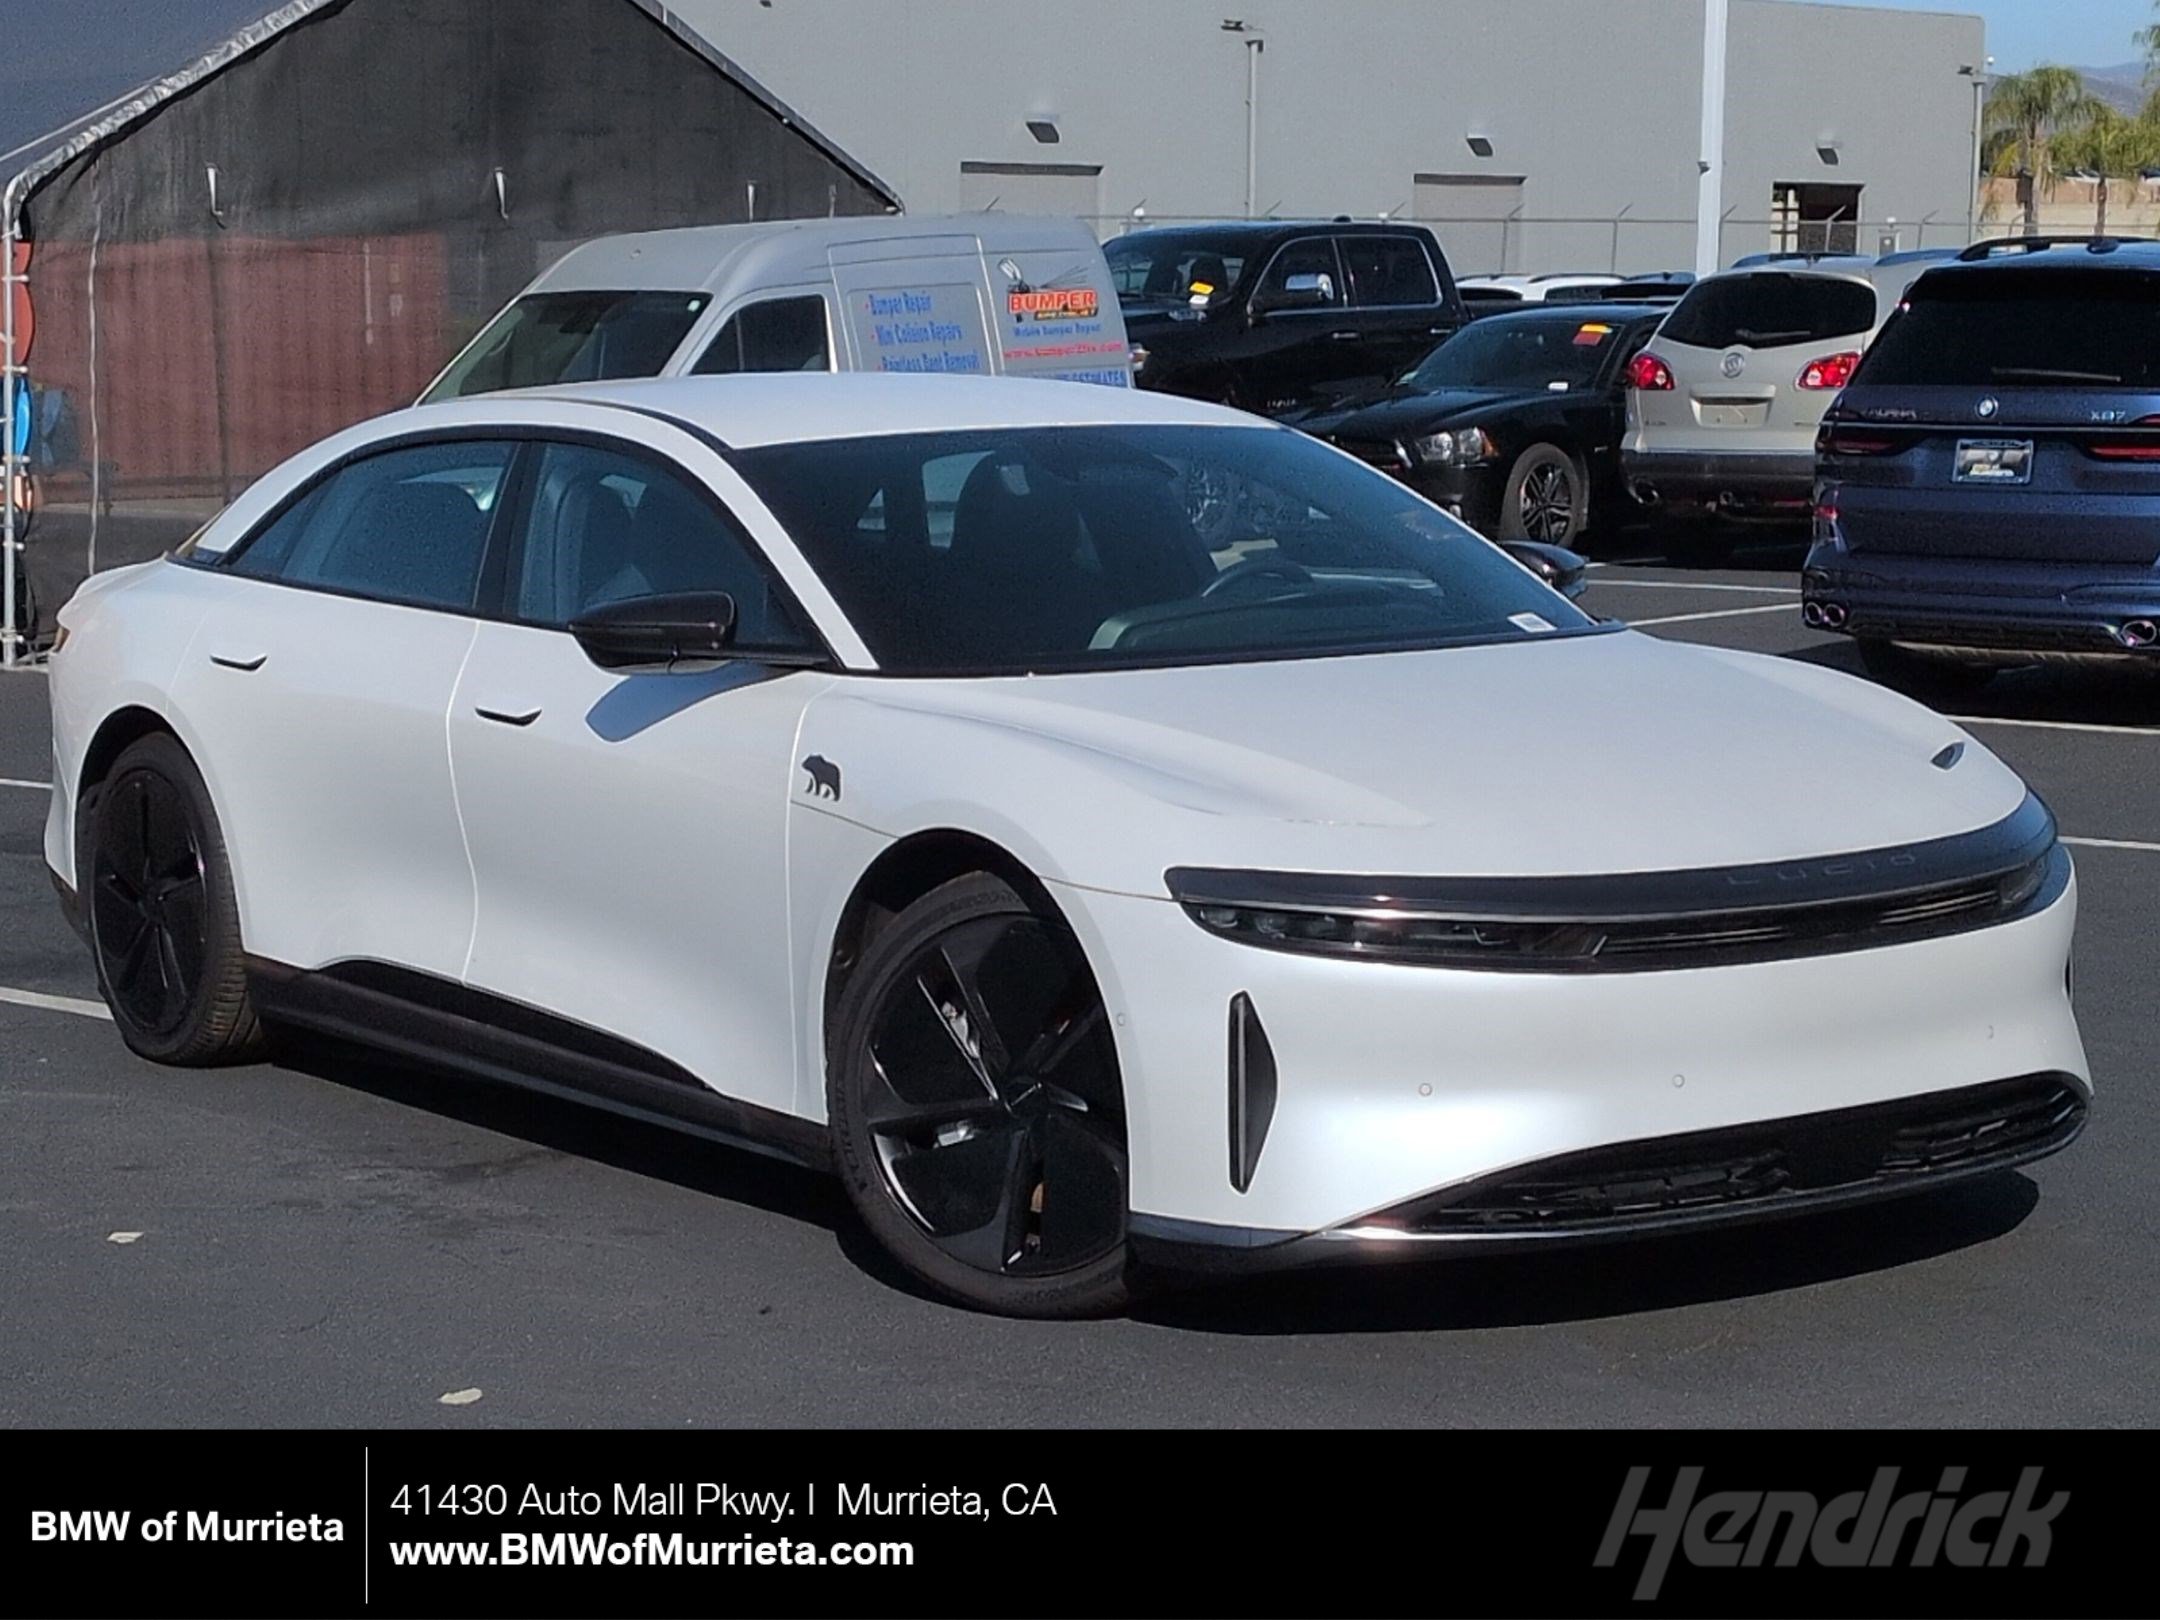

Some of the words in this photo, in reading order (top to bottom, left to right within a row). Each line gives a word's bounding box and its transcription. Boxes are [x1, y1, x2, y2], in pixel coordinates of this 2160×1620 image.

[869, 293, 902, 318] Bumper
[903, 290, 932, 315] Repair
[1008, 289, 1098, 315] BUMPER
